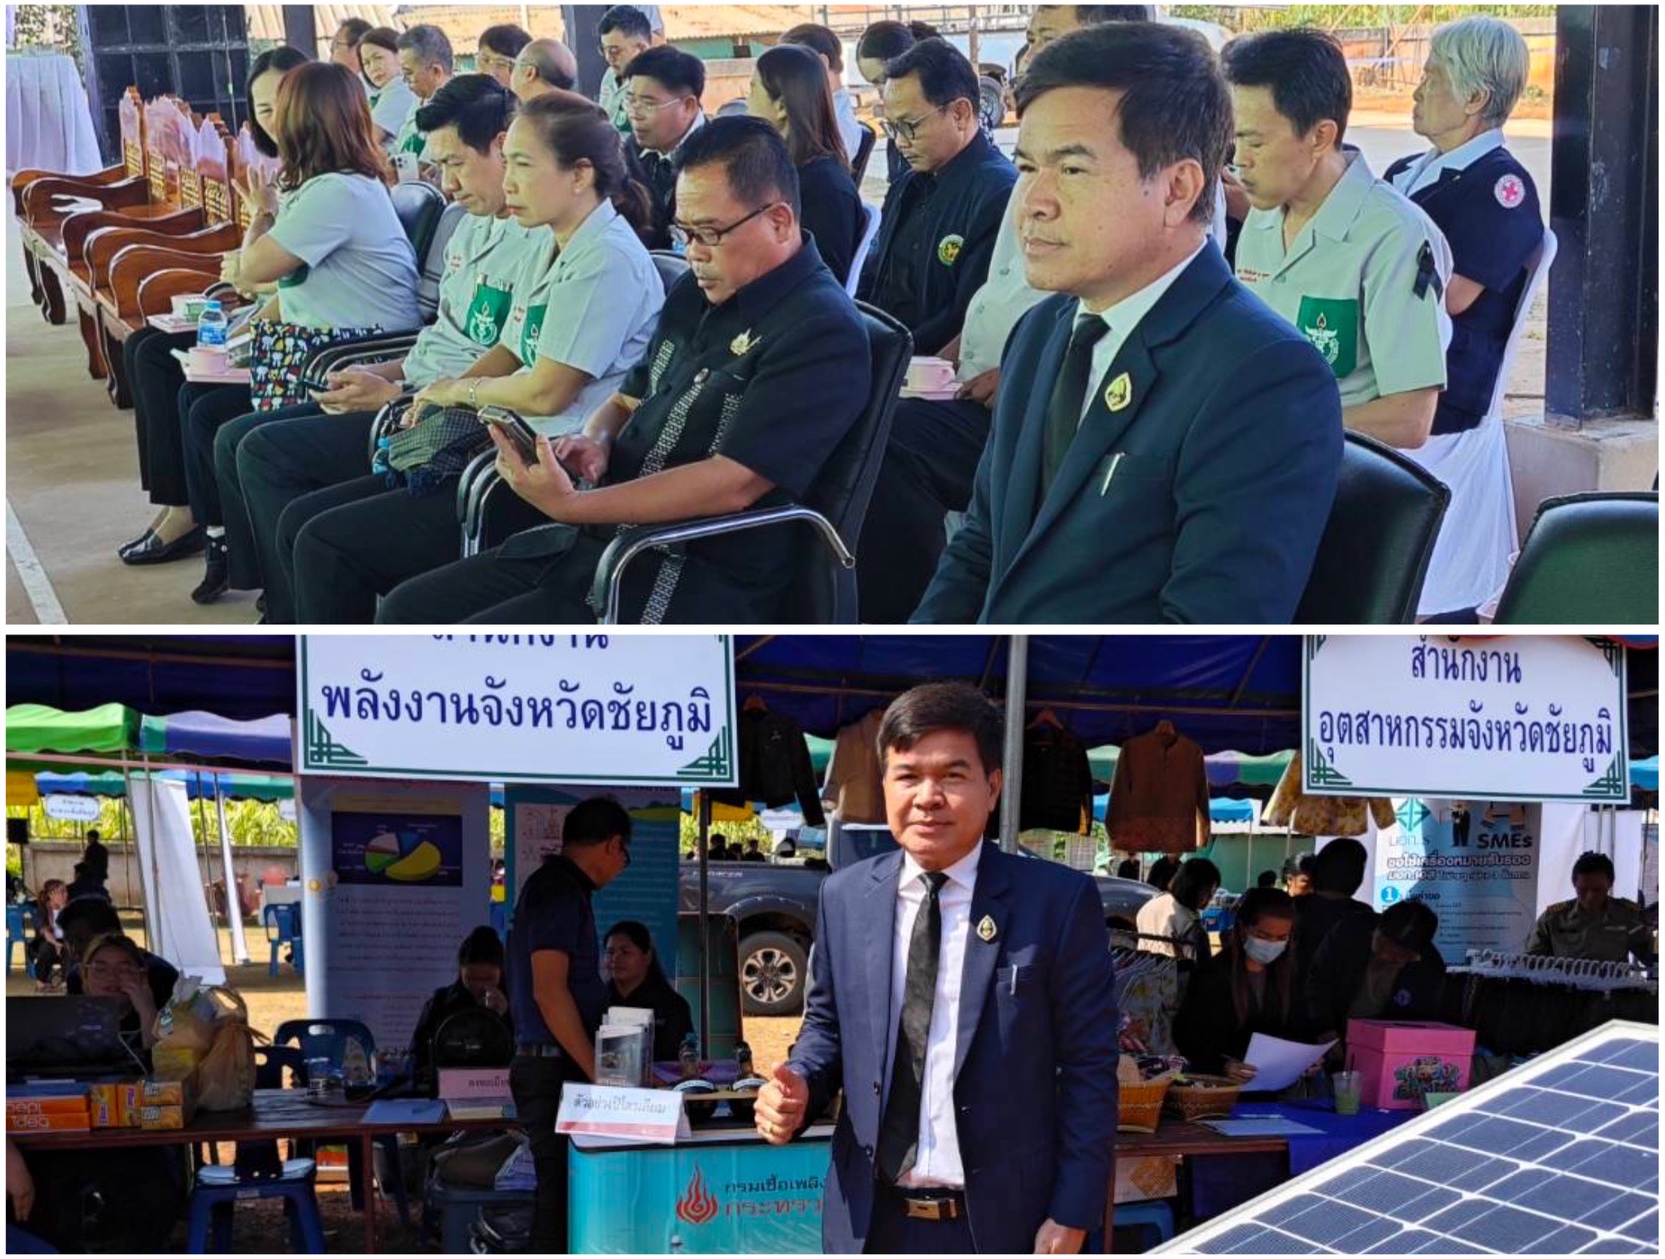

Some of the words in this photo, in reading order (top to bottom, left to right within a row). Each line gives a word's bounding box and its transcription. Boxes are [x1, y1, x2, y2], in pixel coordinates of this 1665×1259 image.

[321, 668, 712, 751] พลังงานจังหวัดชัยภูมิ
[1318, 699, 1613, 774] อุตสาหกรรมจังหวัดชัยภูมิ
[1477, 833, 1533, 848] SMEs
